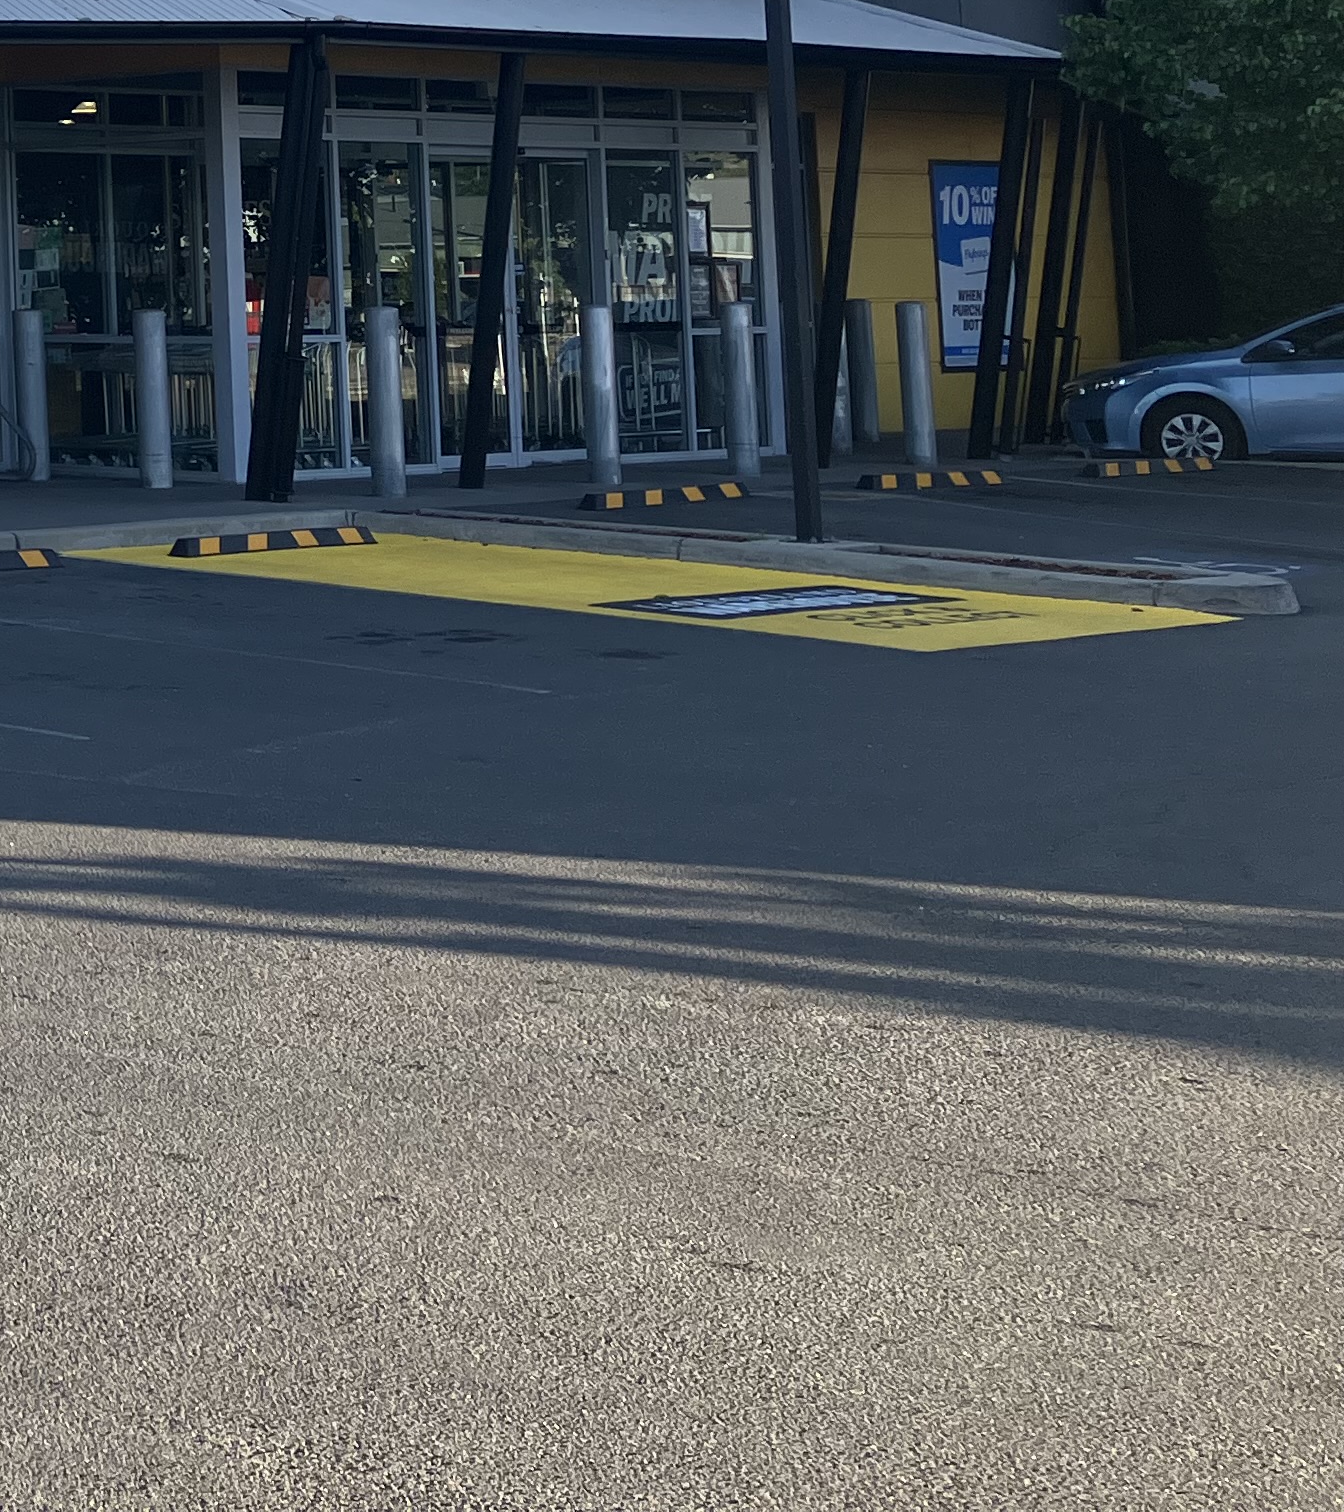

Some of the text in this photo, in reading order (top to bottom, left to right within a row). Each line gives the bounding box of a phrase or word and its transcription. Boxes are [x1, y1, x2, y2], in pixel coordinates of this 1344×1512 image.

[982, 187, 998, 203] OF
[972, 206, 995, 225] WIN
[958, 290, 982, 301] WHEN
